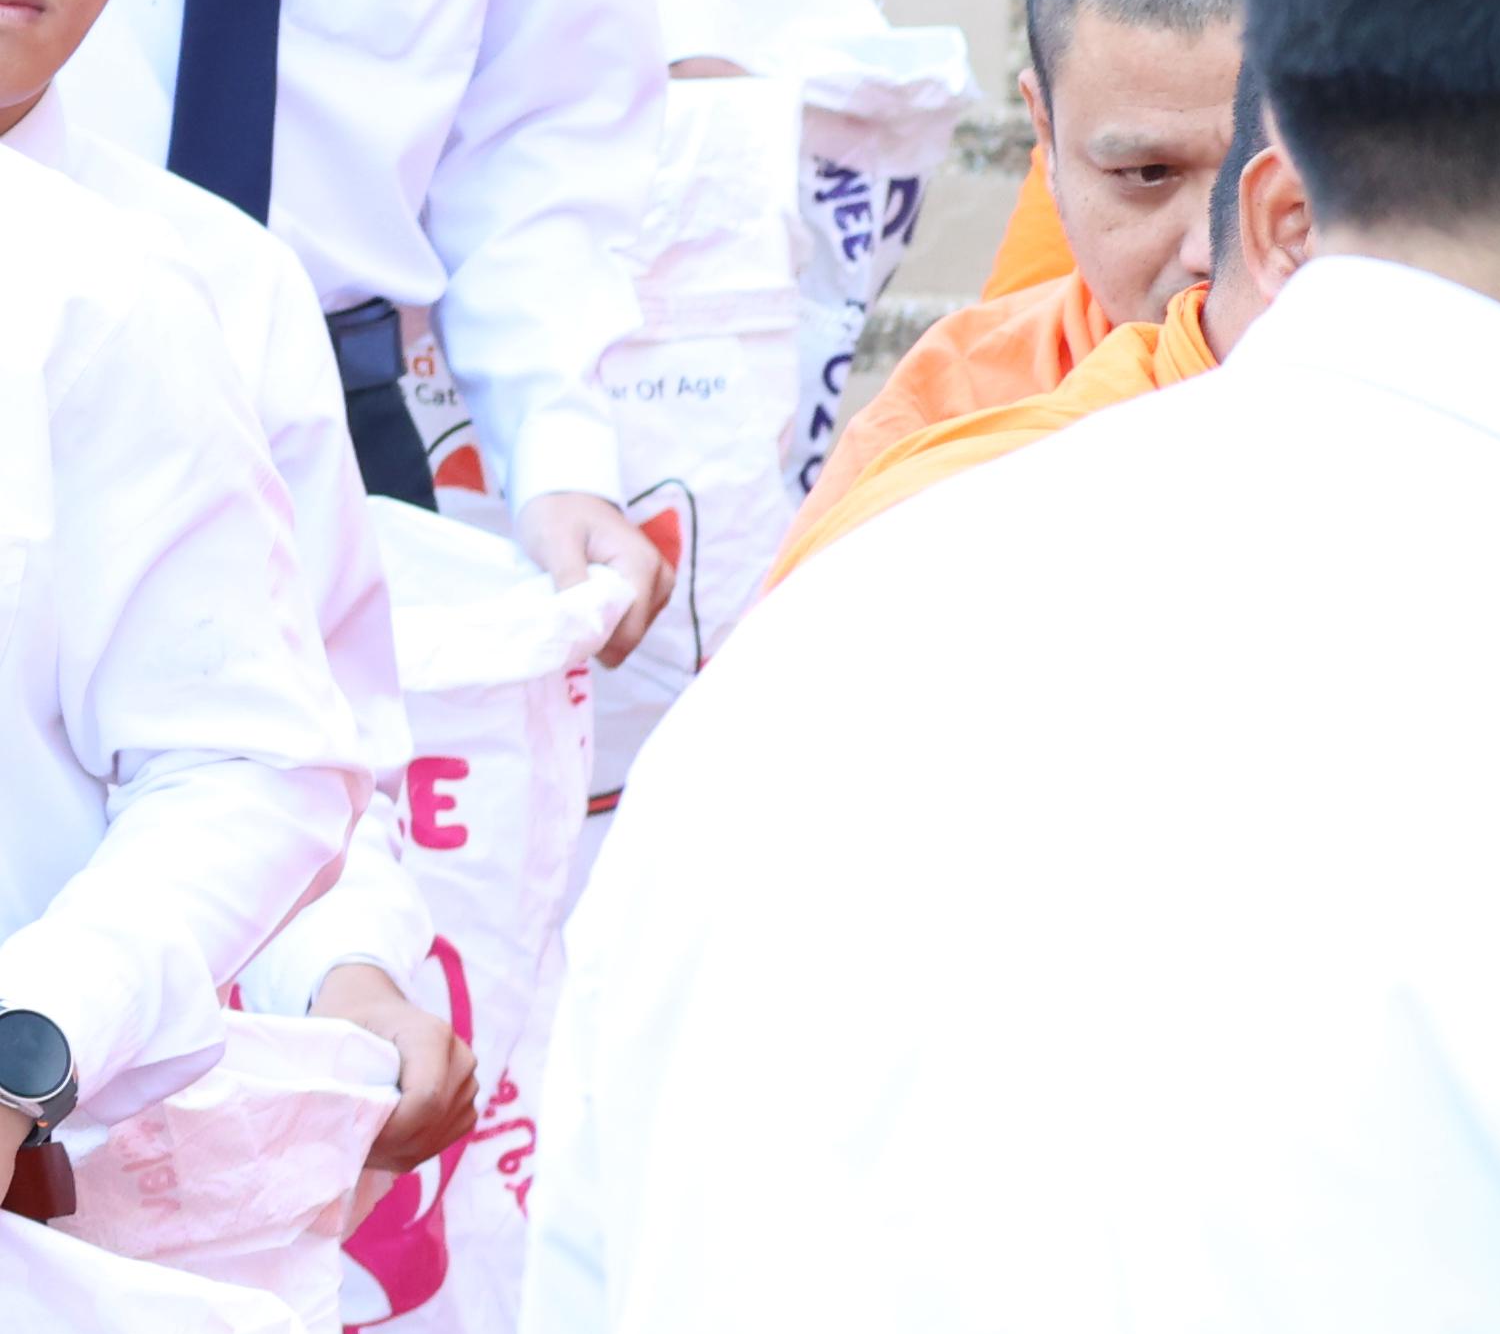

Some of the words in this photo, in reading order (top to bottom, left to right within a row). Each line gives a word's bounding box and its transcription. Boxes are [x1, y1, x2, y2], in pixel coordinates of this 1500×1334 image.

[414, 383, 458, 406] Cat
[636, 377, 665, 401] Of
[677, 375, 726, 399] Age
